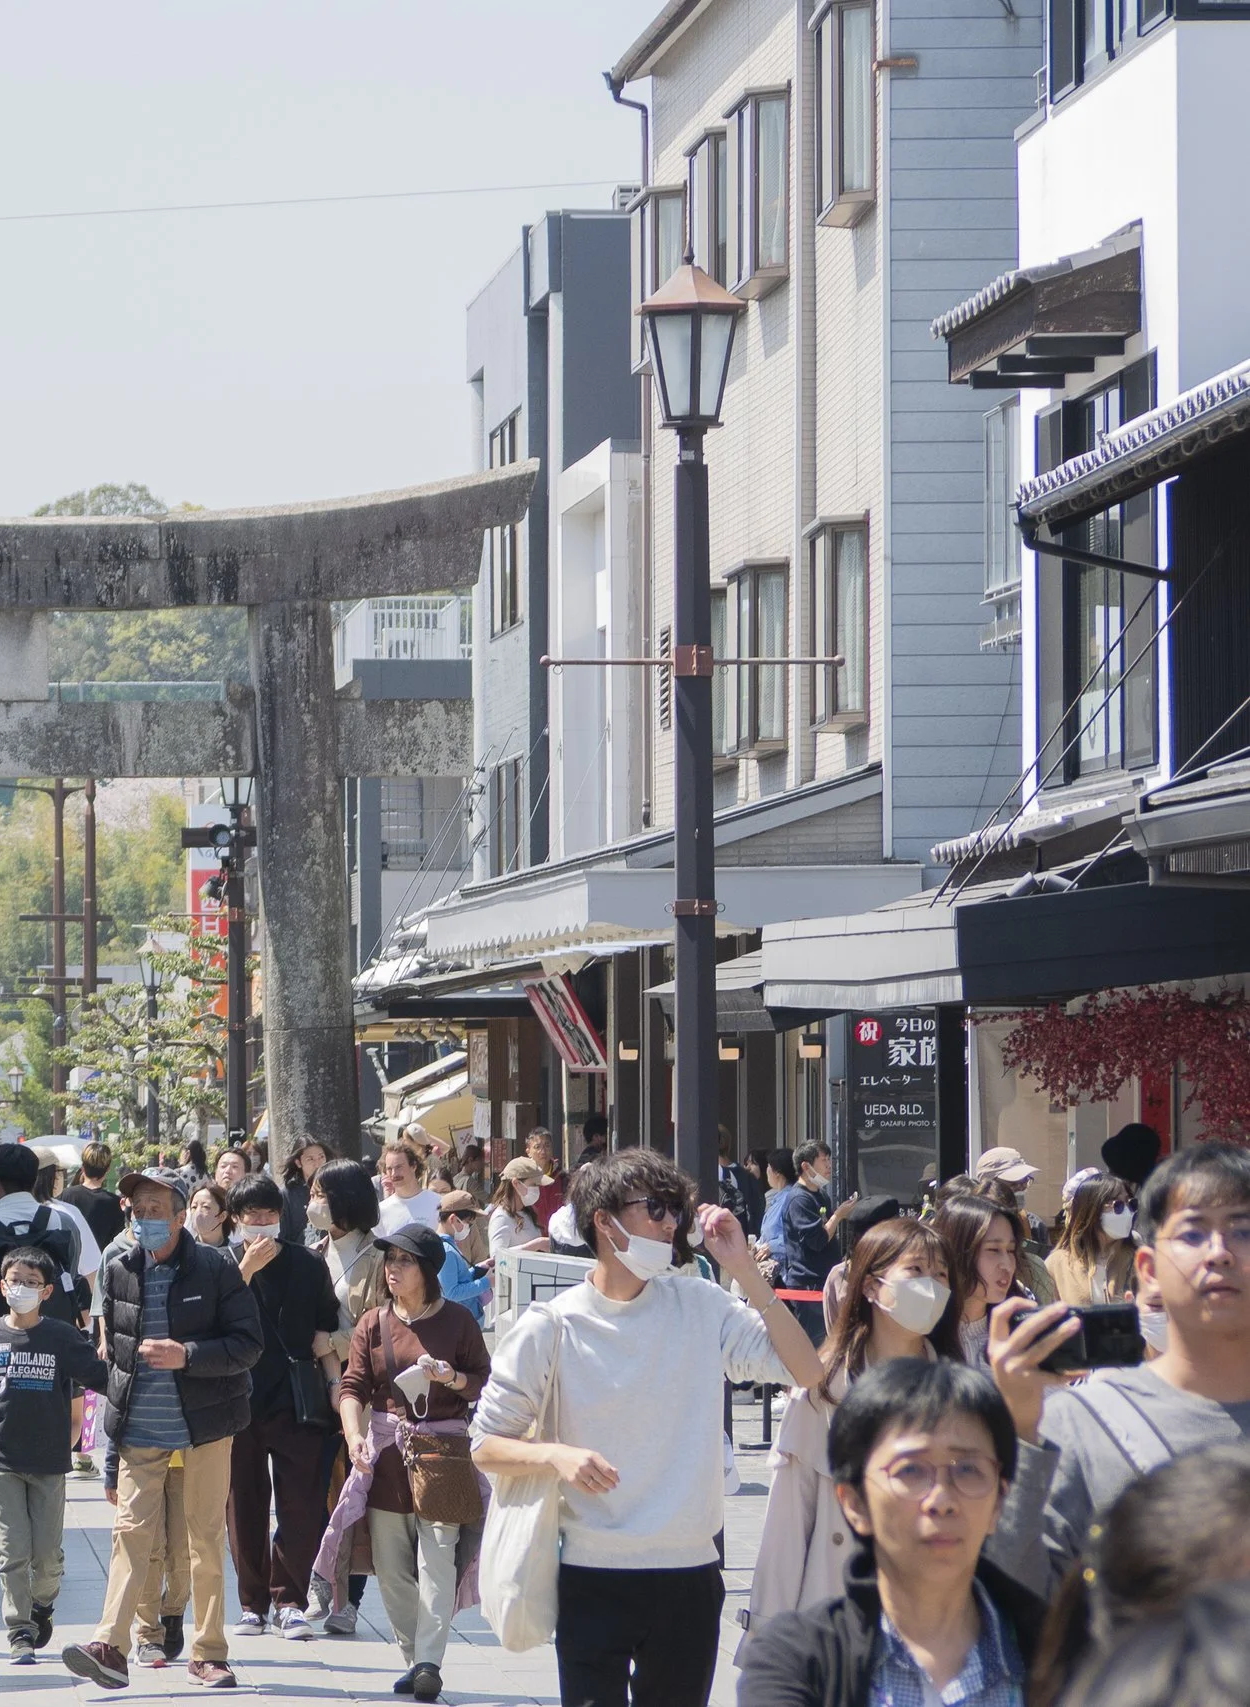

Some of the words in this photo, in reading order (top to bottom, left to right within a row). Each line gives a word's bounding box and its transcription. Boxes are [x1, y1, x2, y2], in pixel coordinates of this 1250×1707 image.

[895, 1017, 936, 1032] 今日の
[859, 1021, 878, 1042] 祝
[859, 1074, 922, 1086] エレベーター
[864, 1103, 897, 1116] UEDA
[899, 1103, 925, 1116] BLD.
[864, 1119, 875, 1128] 3F
[10, 1351, 56, 1368] MIDLANDS
[7, 1365, 55, 1377] ELEGANCE
